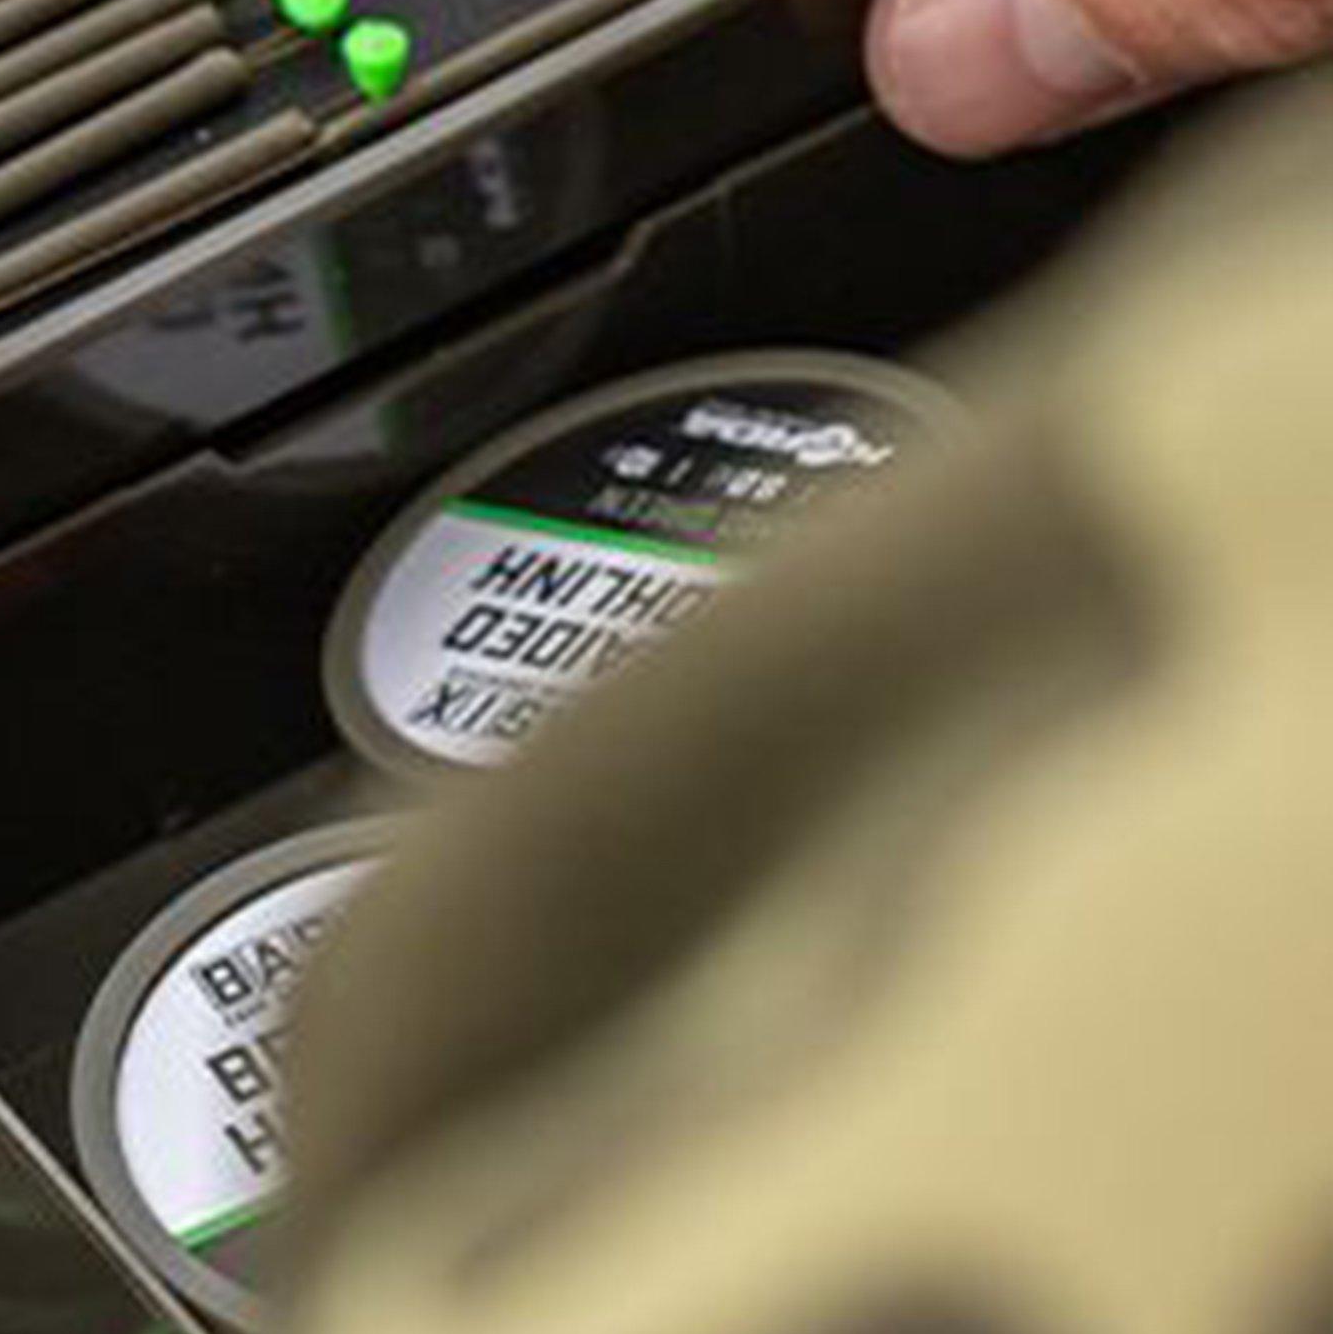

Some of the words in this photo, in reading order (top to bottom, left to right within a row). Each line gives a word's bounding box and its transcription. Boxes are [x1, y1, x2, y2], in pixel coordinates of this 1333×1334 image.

[470, 546, 710, 628] OKLINK
[442, 604, 633, 676] AIDED
[409, 685, 541, 738] SIX
